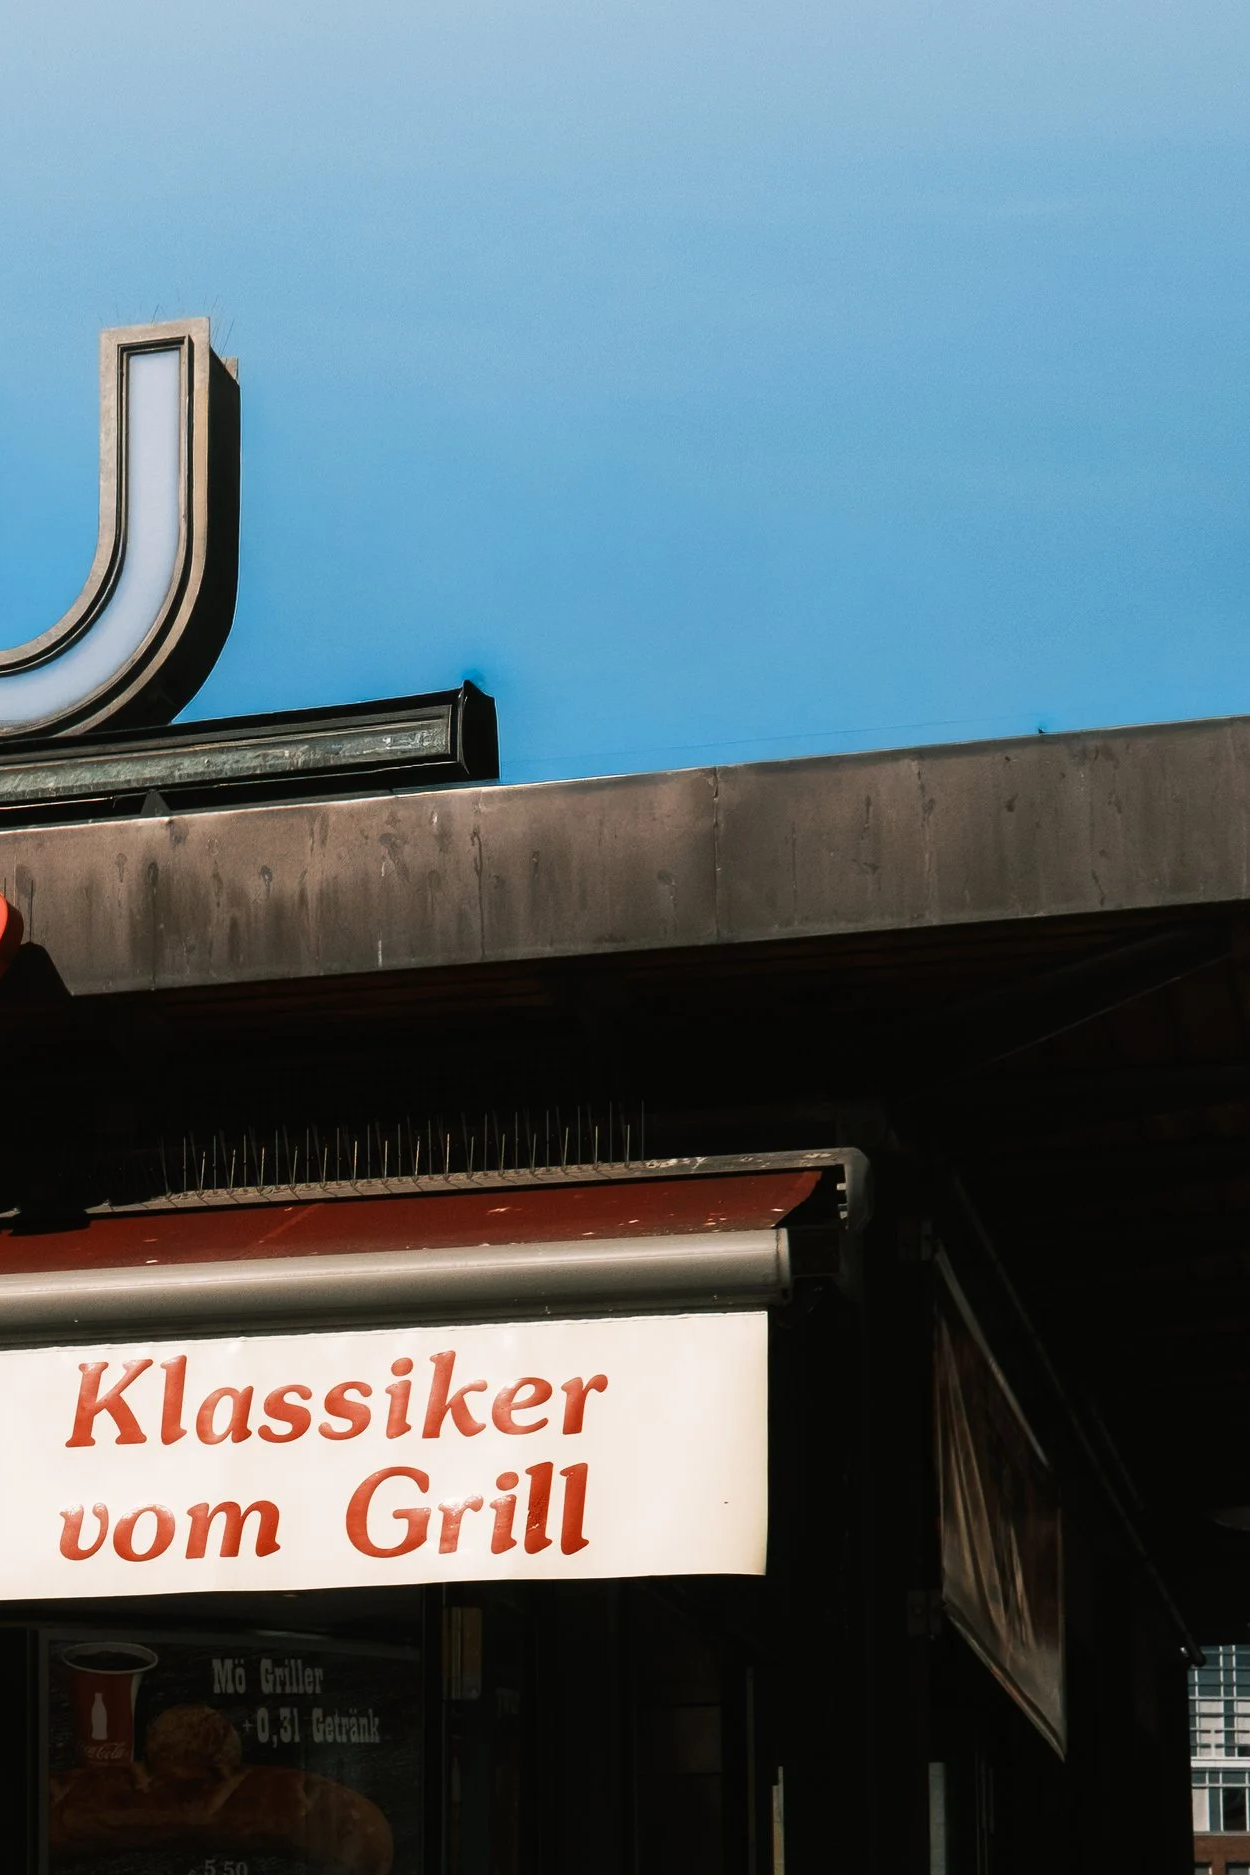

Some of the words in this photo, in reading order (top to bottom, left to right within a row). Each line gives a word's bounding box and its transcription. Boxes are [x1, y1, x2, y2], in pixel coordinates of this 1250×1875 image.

[64, 1350, 608, 1448] Klassiker
[58, 1501, 281, 1562] vom
[346, 1462, 590, 1560] Grill
[211, 1658, 247, 1695] Mö
[259, 1658, 324, 1696] Griller
[311, 1707, 381, 1744] Getränk
